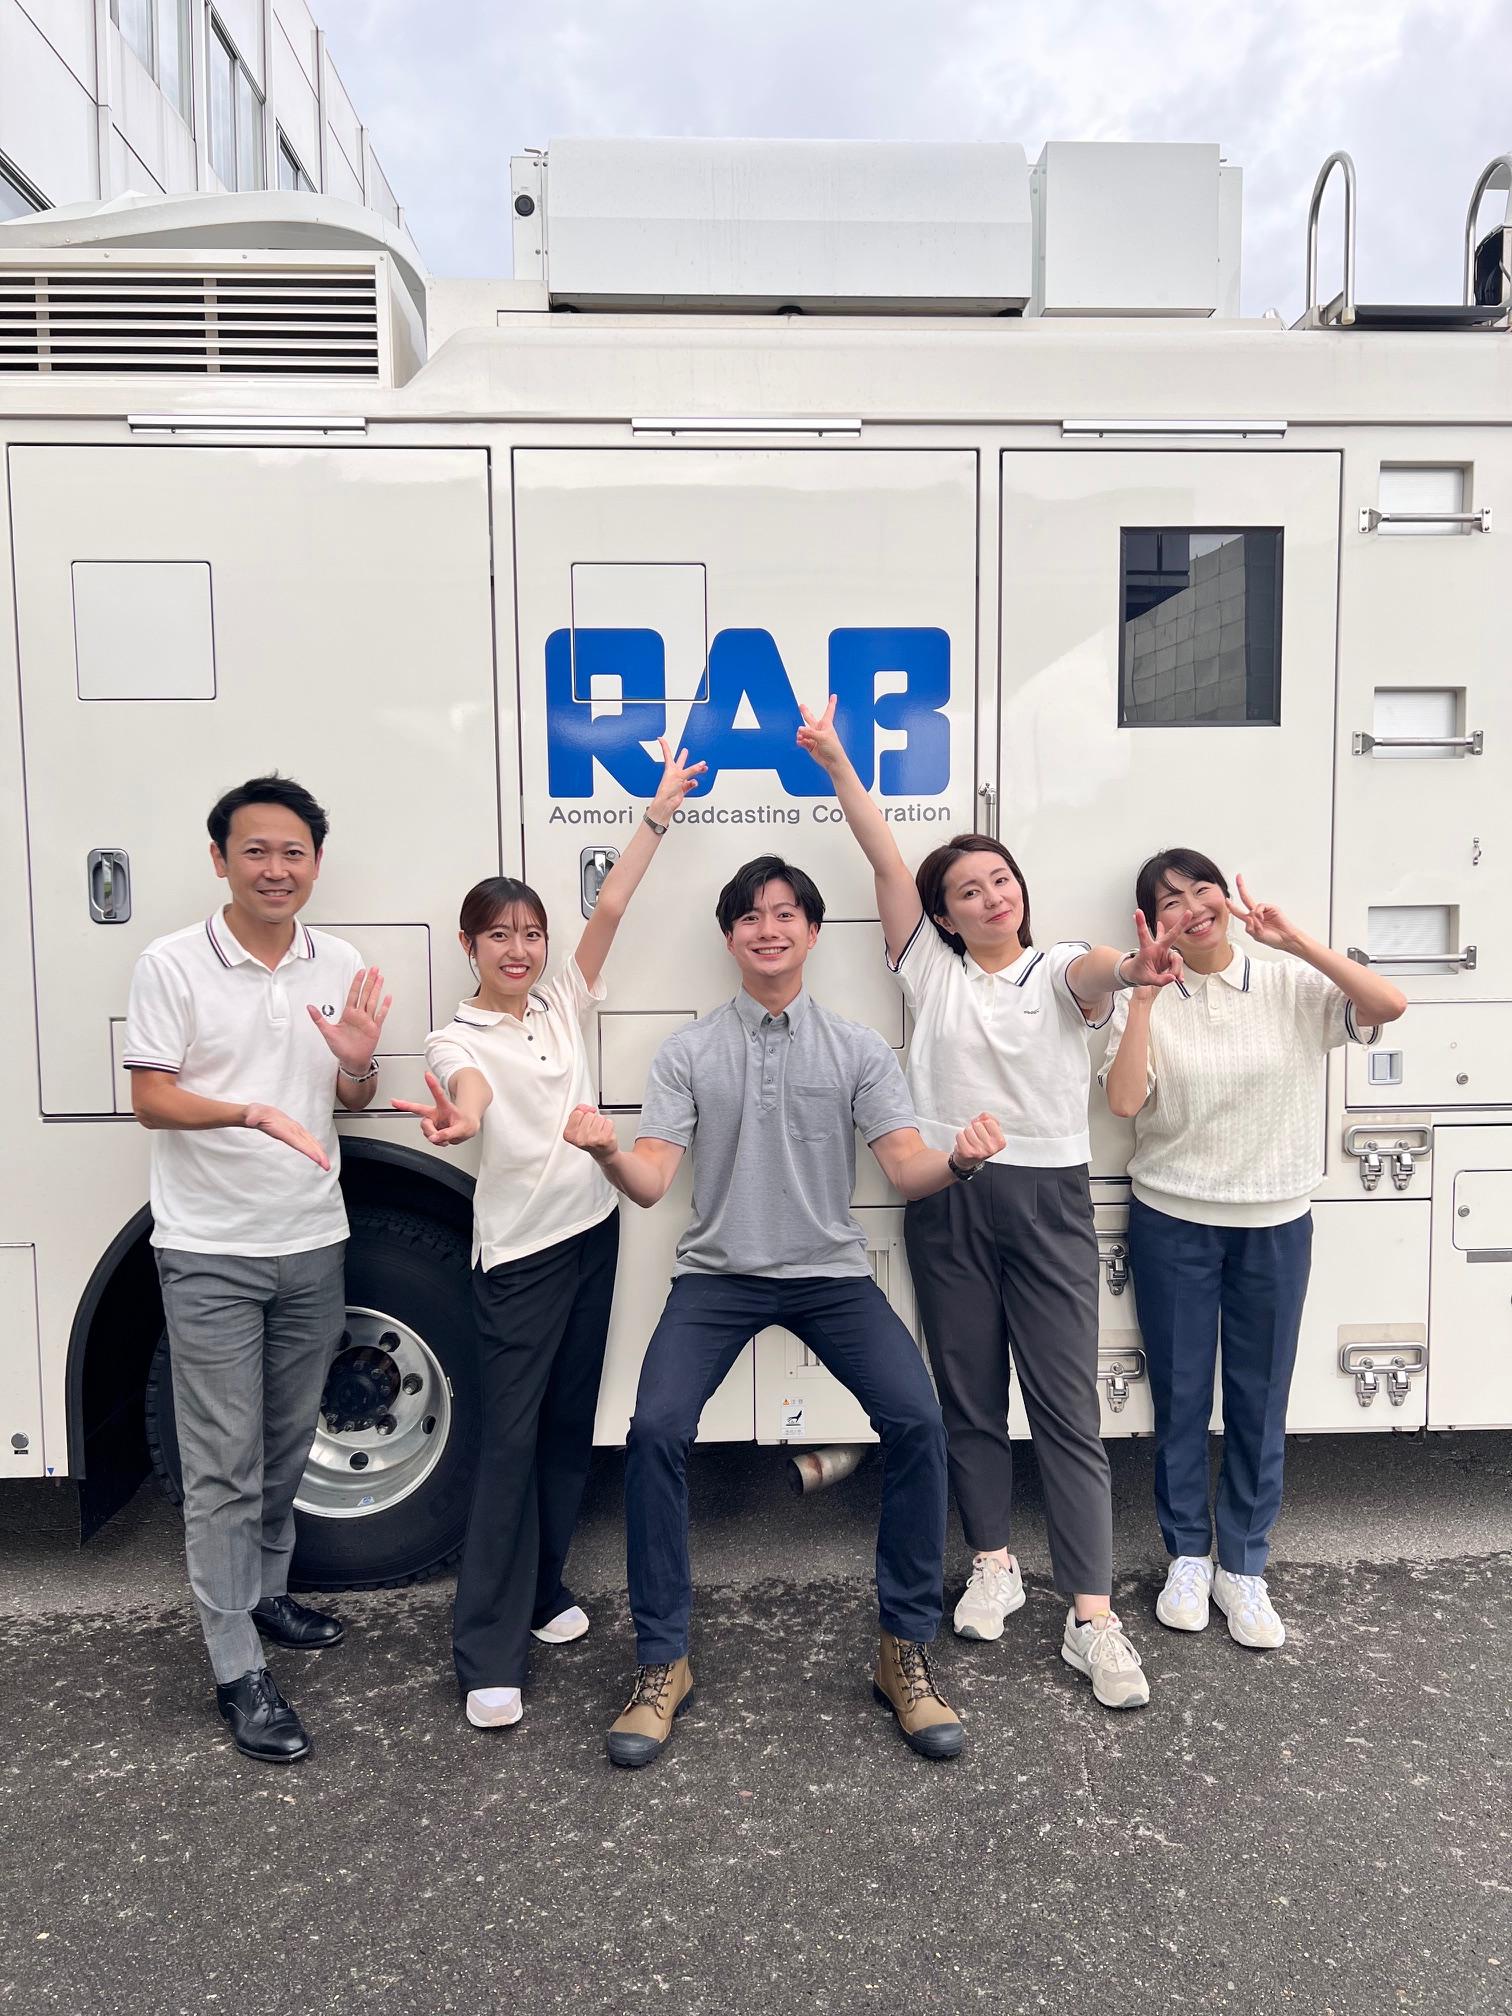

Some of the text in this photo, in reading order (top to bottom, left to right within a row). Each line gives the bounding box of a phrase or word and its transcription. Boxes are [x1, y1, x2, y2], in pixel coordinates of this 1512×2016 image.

[545, 627, 951, 798] RAB
[549, 804, 951, 825] Aomori oadcasting Coration
